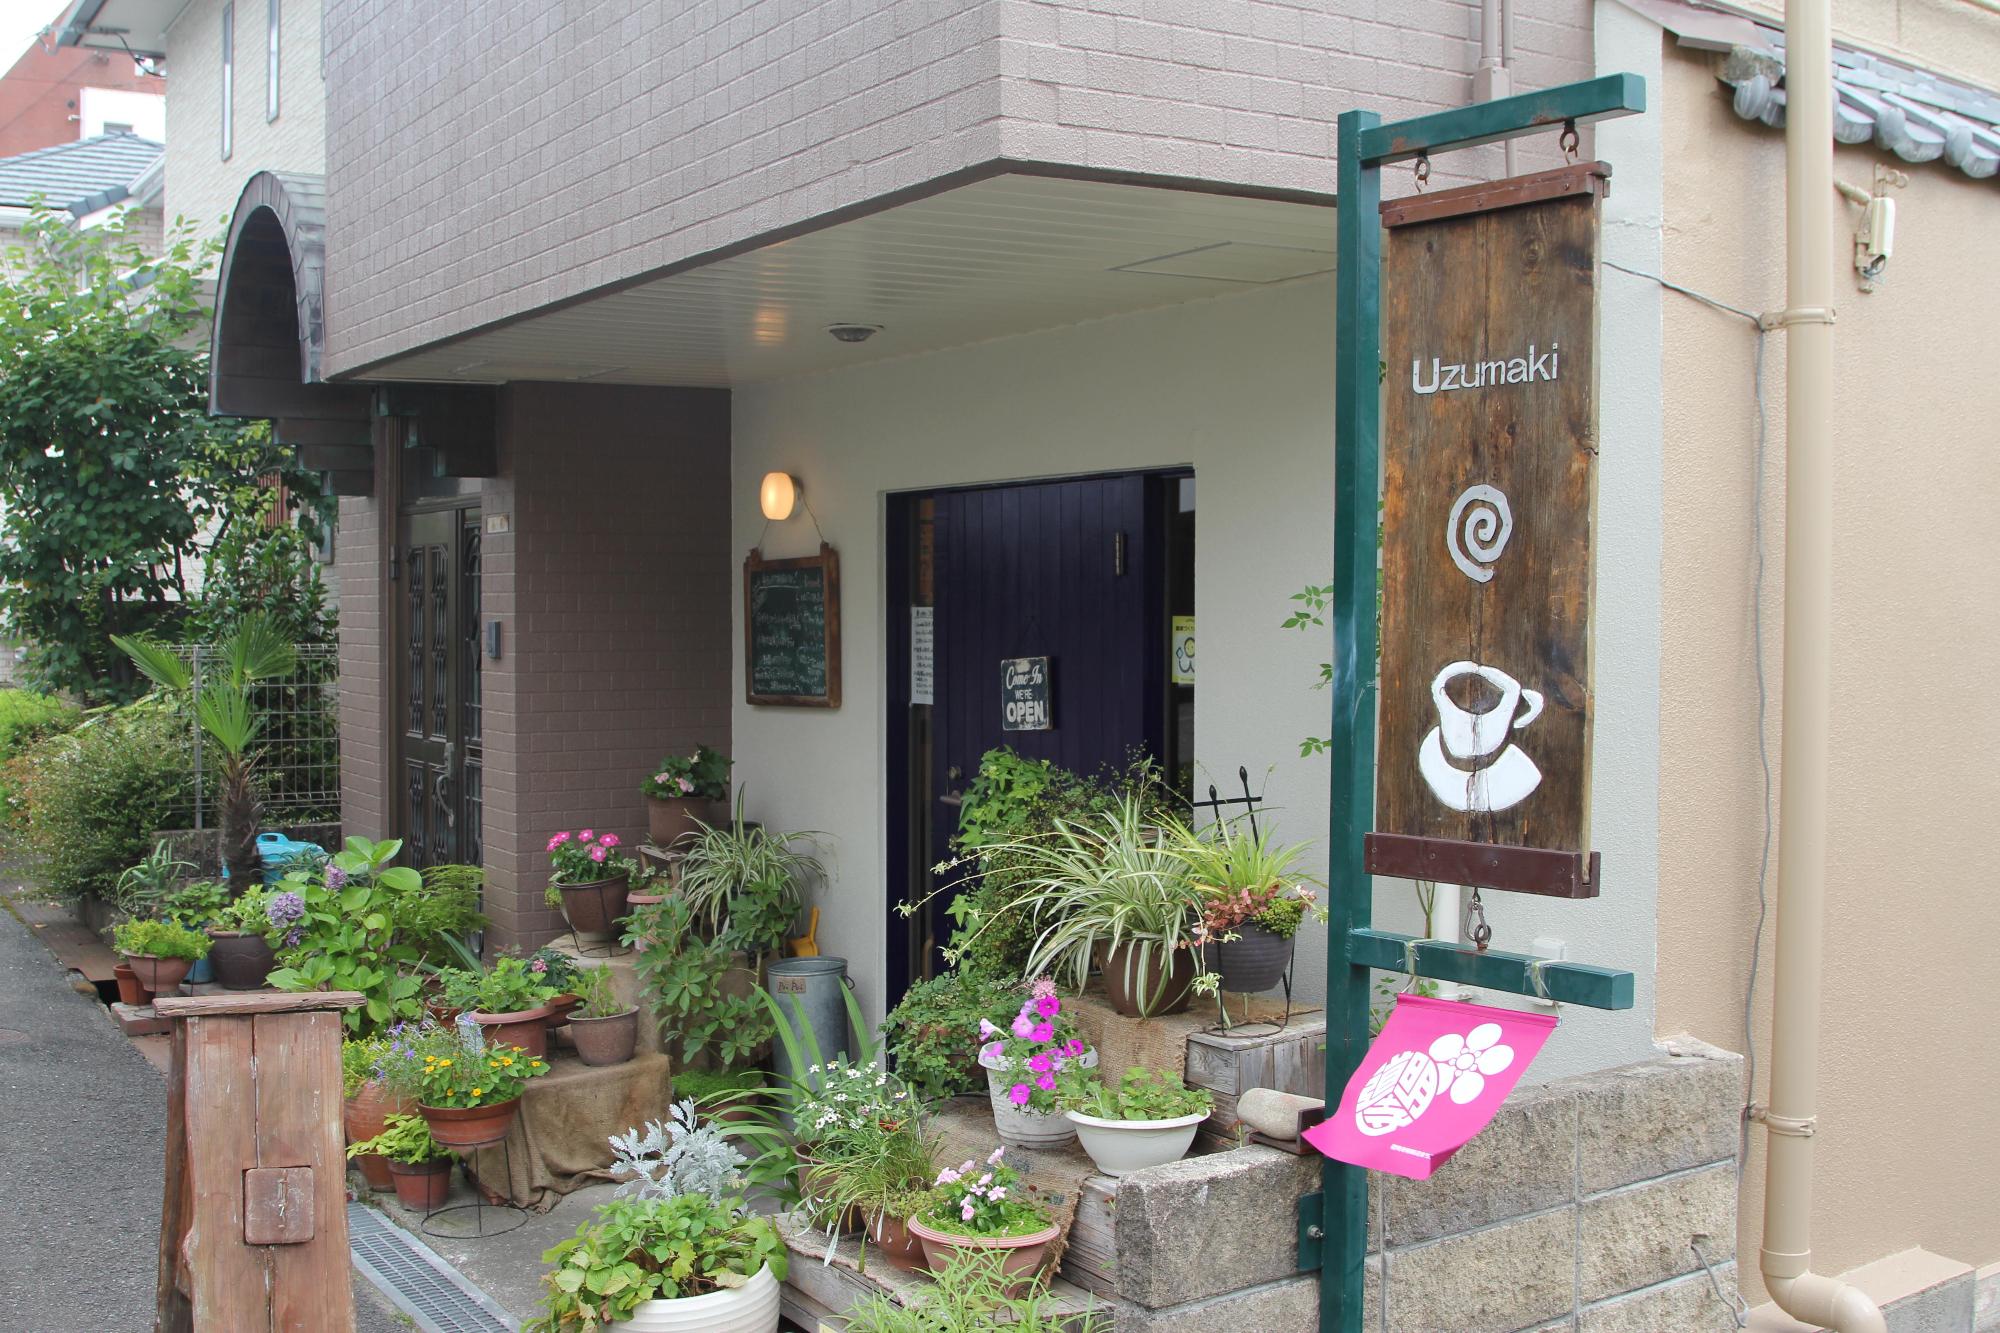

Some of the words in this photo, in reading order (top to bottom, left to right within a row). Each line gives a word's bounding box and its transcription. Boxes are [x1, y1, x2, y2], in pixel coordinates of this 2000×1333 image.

[1412, 342, 1558, 394] Uzumaki
[1006, 665, 1030, 690] Come
[1030, 664, 1043, 685] In
[1014, 688, 1032, 700] WE'RE
[1006, 700, 1044, 723] OPEN
